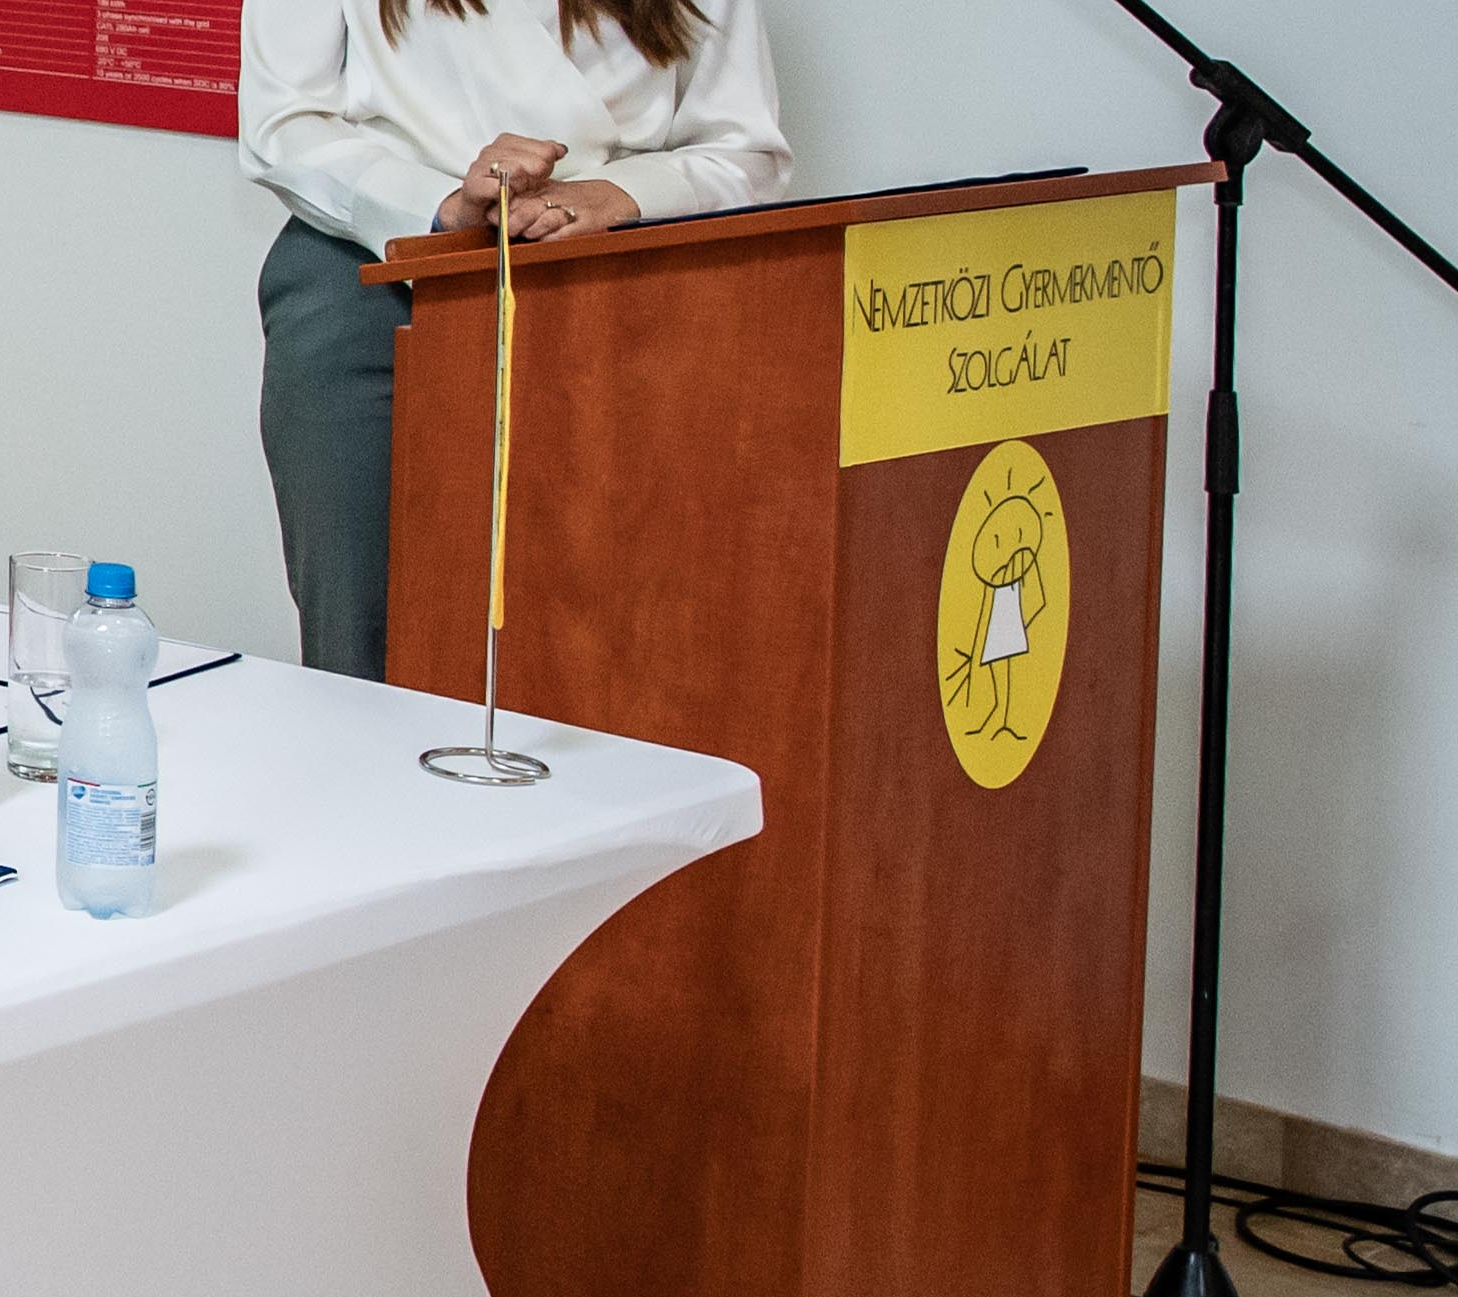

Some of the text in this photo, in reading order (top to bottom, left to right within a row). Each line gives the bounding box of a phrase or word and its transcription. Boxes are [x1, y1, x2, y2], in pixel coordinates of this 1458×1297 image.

[852, 241, 1165, 336] NEMZETKÖZI GYERMEKMENTŐ
[947, 329, 1071, 394] SZOLGÁLAT
